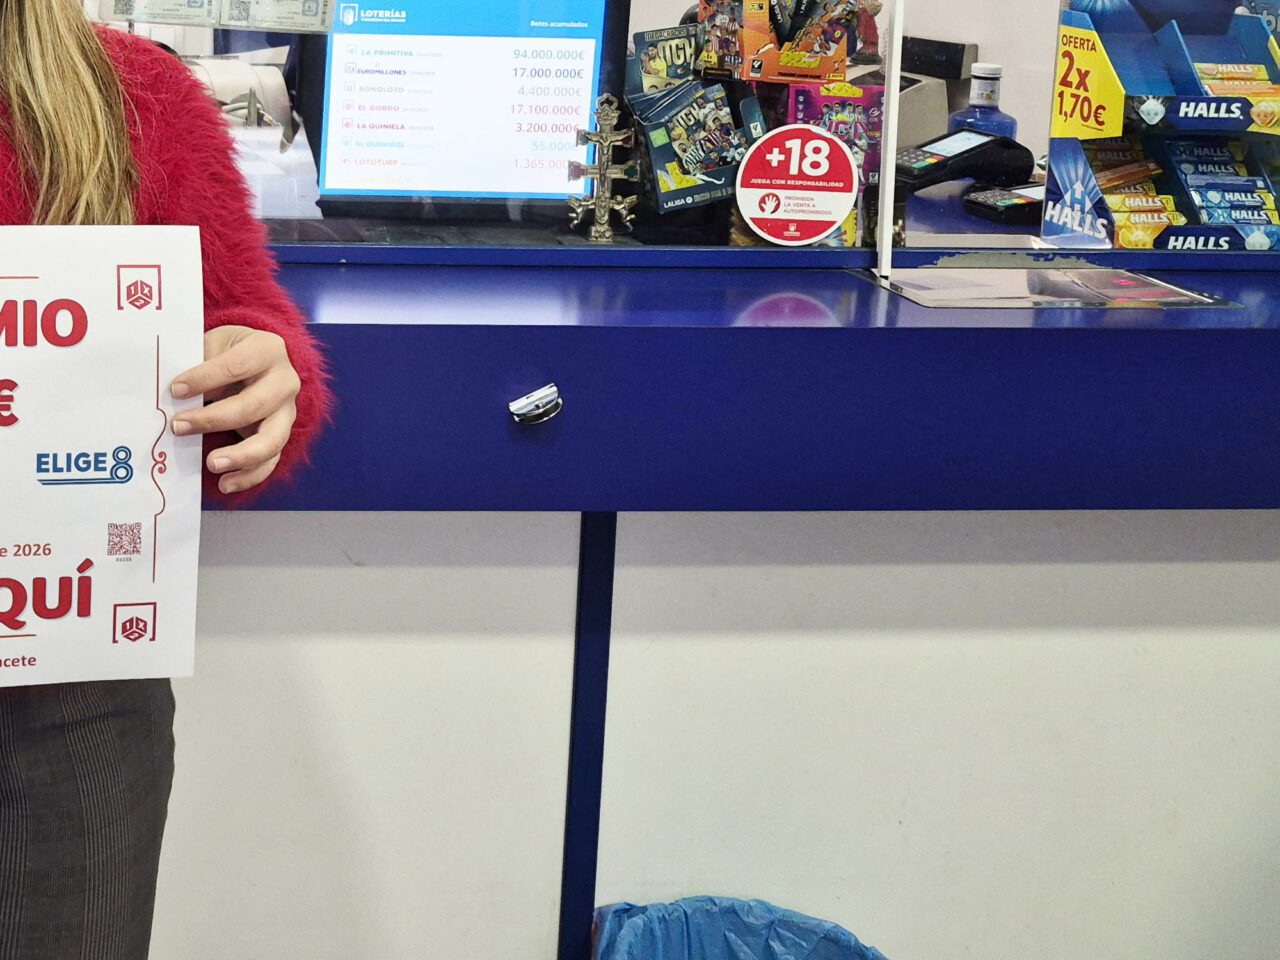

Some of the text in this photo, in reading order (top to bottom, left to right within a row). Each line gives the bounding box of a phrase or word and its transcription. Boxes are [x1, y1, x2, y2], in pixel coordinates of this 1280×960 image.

[361, 8, 407, 19] LOTERÍAS
[1061, 34, 1097, 52] OFERTA
[513, 49, 585, 61] 94.000.000€
[513, 67, 584, 79] 17.000.000€
[1058, 49, 1091, 92] 2x
[510, 104, 581, 115] 17.100.000€
[1058, 90, 1107, 127] 1,70€
[766, 138, 830, 176] +18
[1125, 198, 1161, 207] HALLS
[1224, 193, 1262, 201] HALLS
[664, 198, 685, 209] LALIGA
[1130, 213, 1168, 222] HALLS
[1231, 210, 1269, 219] HALLS
[1167, 236, 1230, 250] HALLS
[13, 543, 52, 557] 2026
